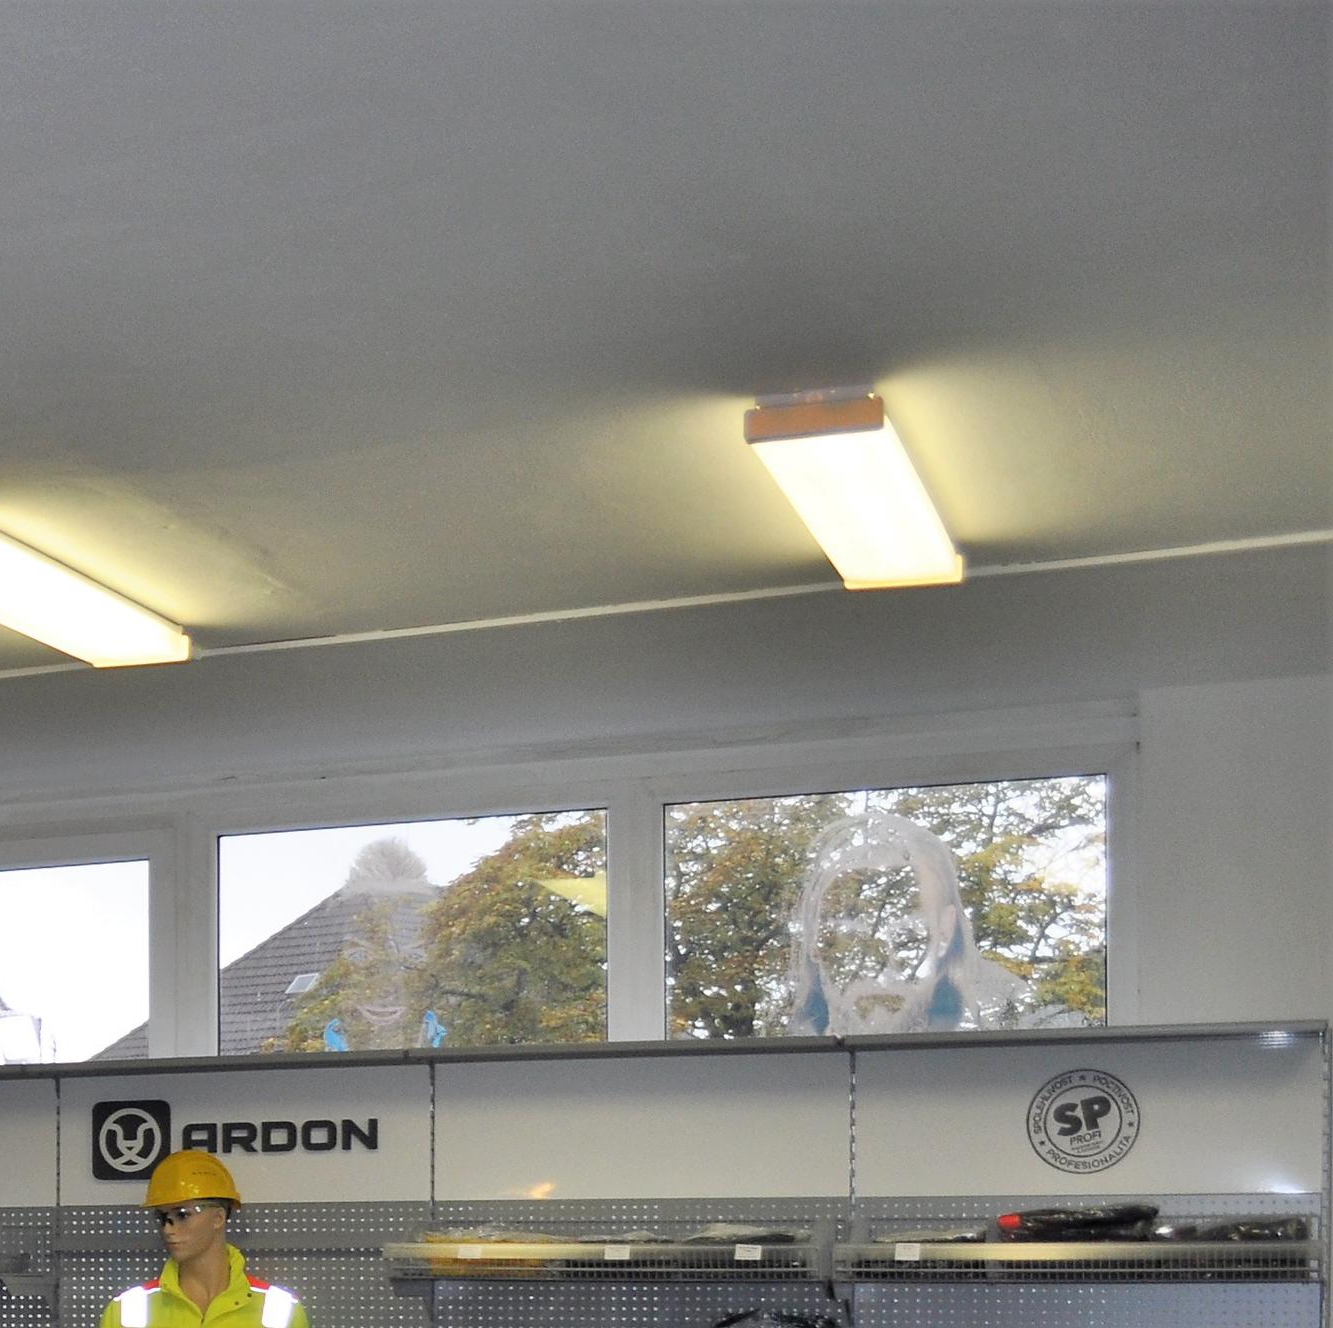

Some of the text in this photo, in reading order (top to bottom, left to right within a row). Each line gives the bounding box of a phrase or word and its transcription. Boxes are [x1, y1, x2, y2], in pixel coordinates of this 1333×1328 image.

[1033, 1075, 1073, 1134] SPOLEHLIVOST
[1093, 1074, 1134, 1115] POCTIVOST
[1053, 1096, 1111, 1136] SP
[182, 1118, 378, 1153] ARDON
[1046, 1135, 1131, 1169] PROFESIONALITA
[1069, 1130, 1101, 1146] PROFI
